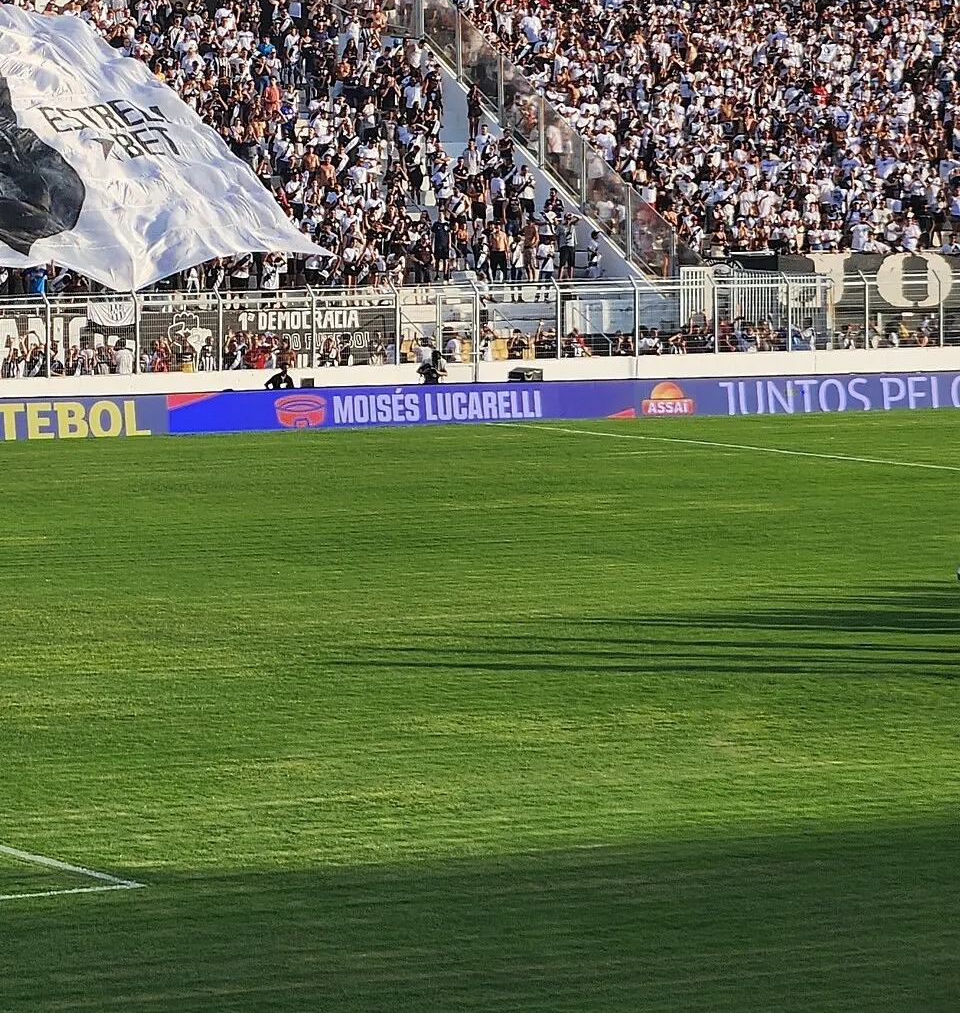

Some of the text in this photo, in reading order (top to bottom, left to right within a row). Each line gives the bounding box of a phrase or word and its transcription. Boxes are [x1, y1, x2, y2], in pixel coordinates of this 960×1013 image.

[258, 310, 360, 331] DEMOCRACIA
[333, 387, 542, 424] MOISÉS LUCARELLI
[647, 399, 689, 414] ASSAÍ
[719, 377, 871, 415] JUNTOS
